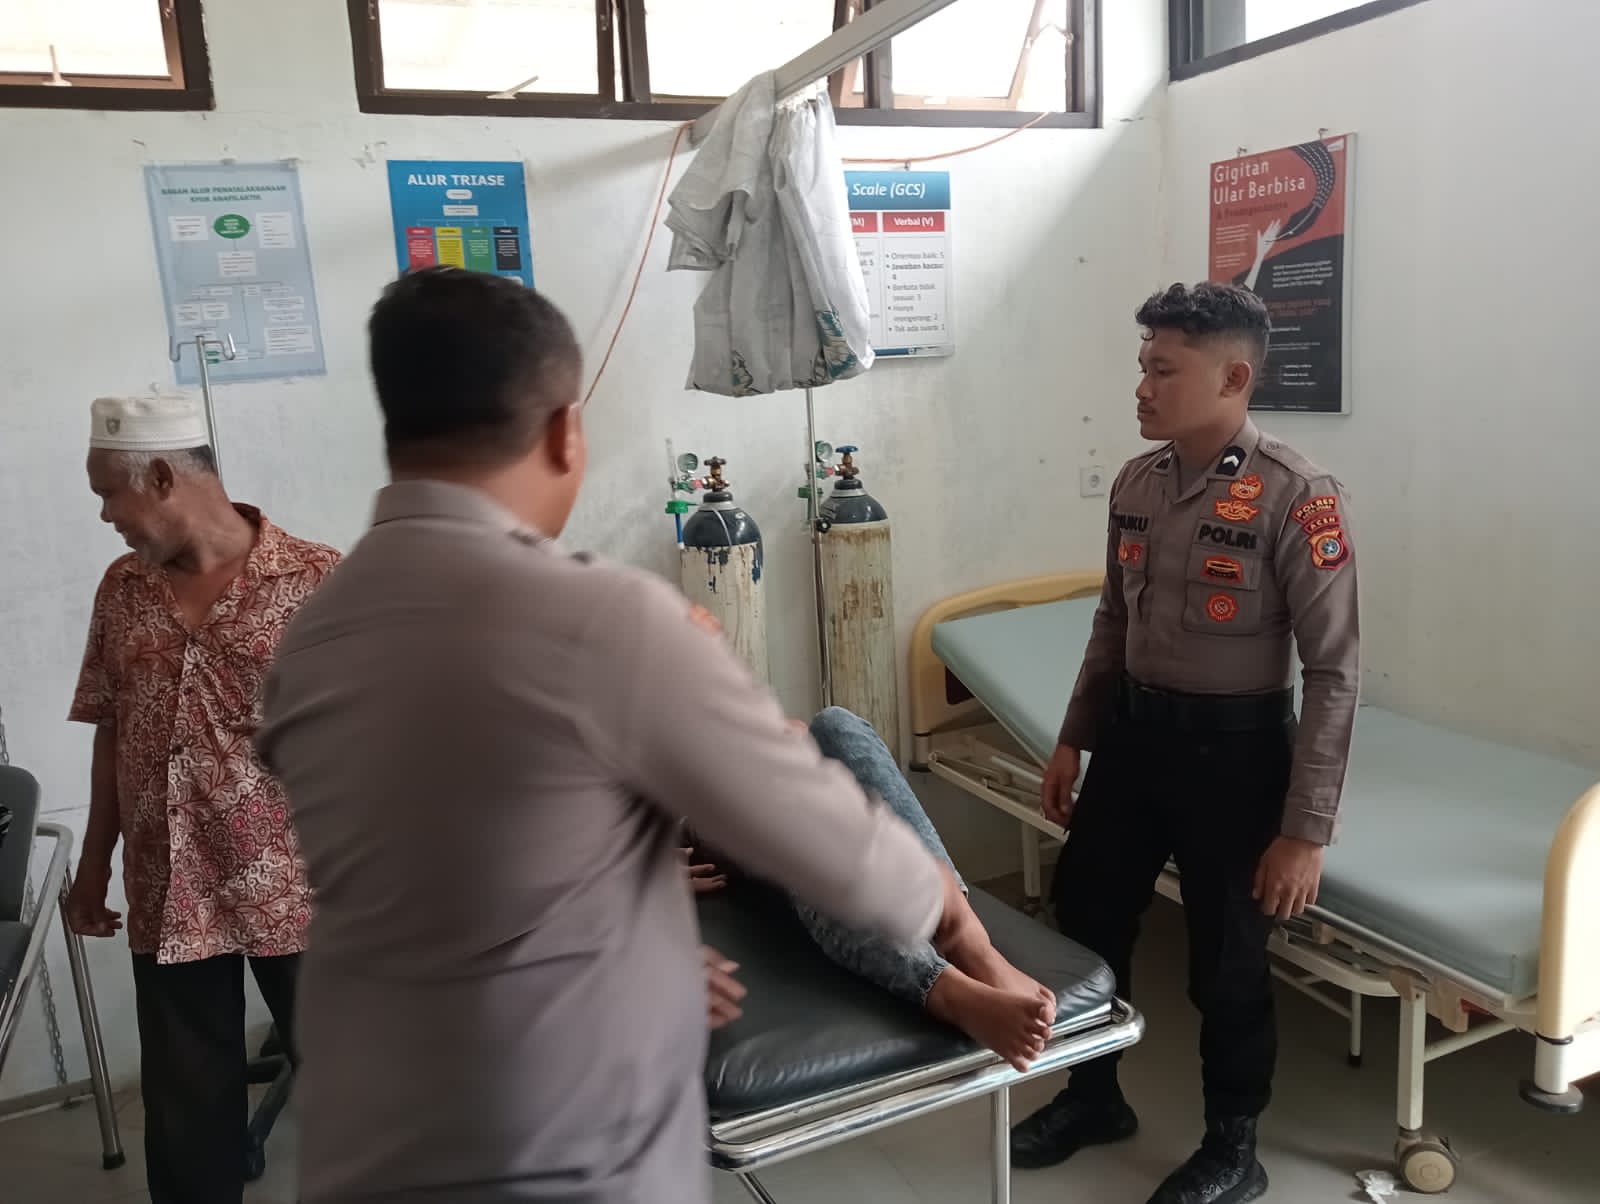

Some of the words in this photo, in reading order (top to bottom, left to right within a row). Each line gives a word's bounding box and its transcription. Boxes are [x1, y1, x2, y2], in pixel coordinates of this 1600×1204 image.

[407, 174, 448, 186] ALUR
[450, 174, 505, 186] TRIASE
[1214, 161, 1269, 185] Gigitan
[851, 183, 887, 196] Scale
[890, 182, 926, 199] (GCS)
[1214, 187, 1244, 205] Ular
[1248, 176, 1305, 199] Berbisa
[894, 217, 920, 226] Verbal
[921, 217, 934, 227] (V)
[1296, 498, 1334, 517] POLRES
[1311, 516, 1336, 529] ACEH
[1198, 523, 1257, 550] POLRI
